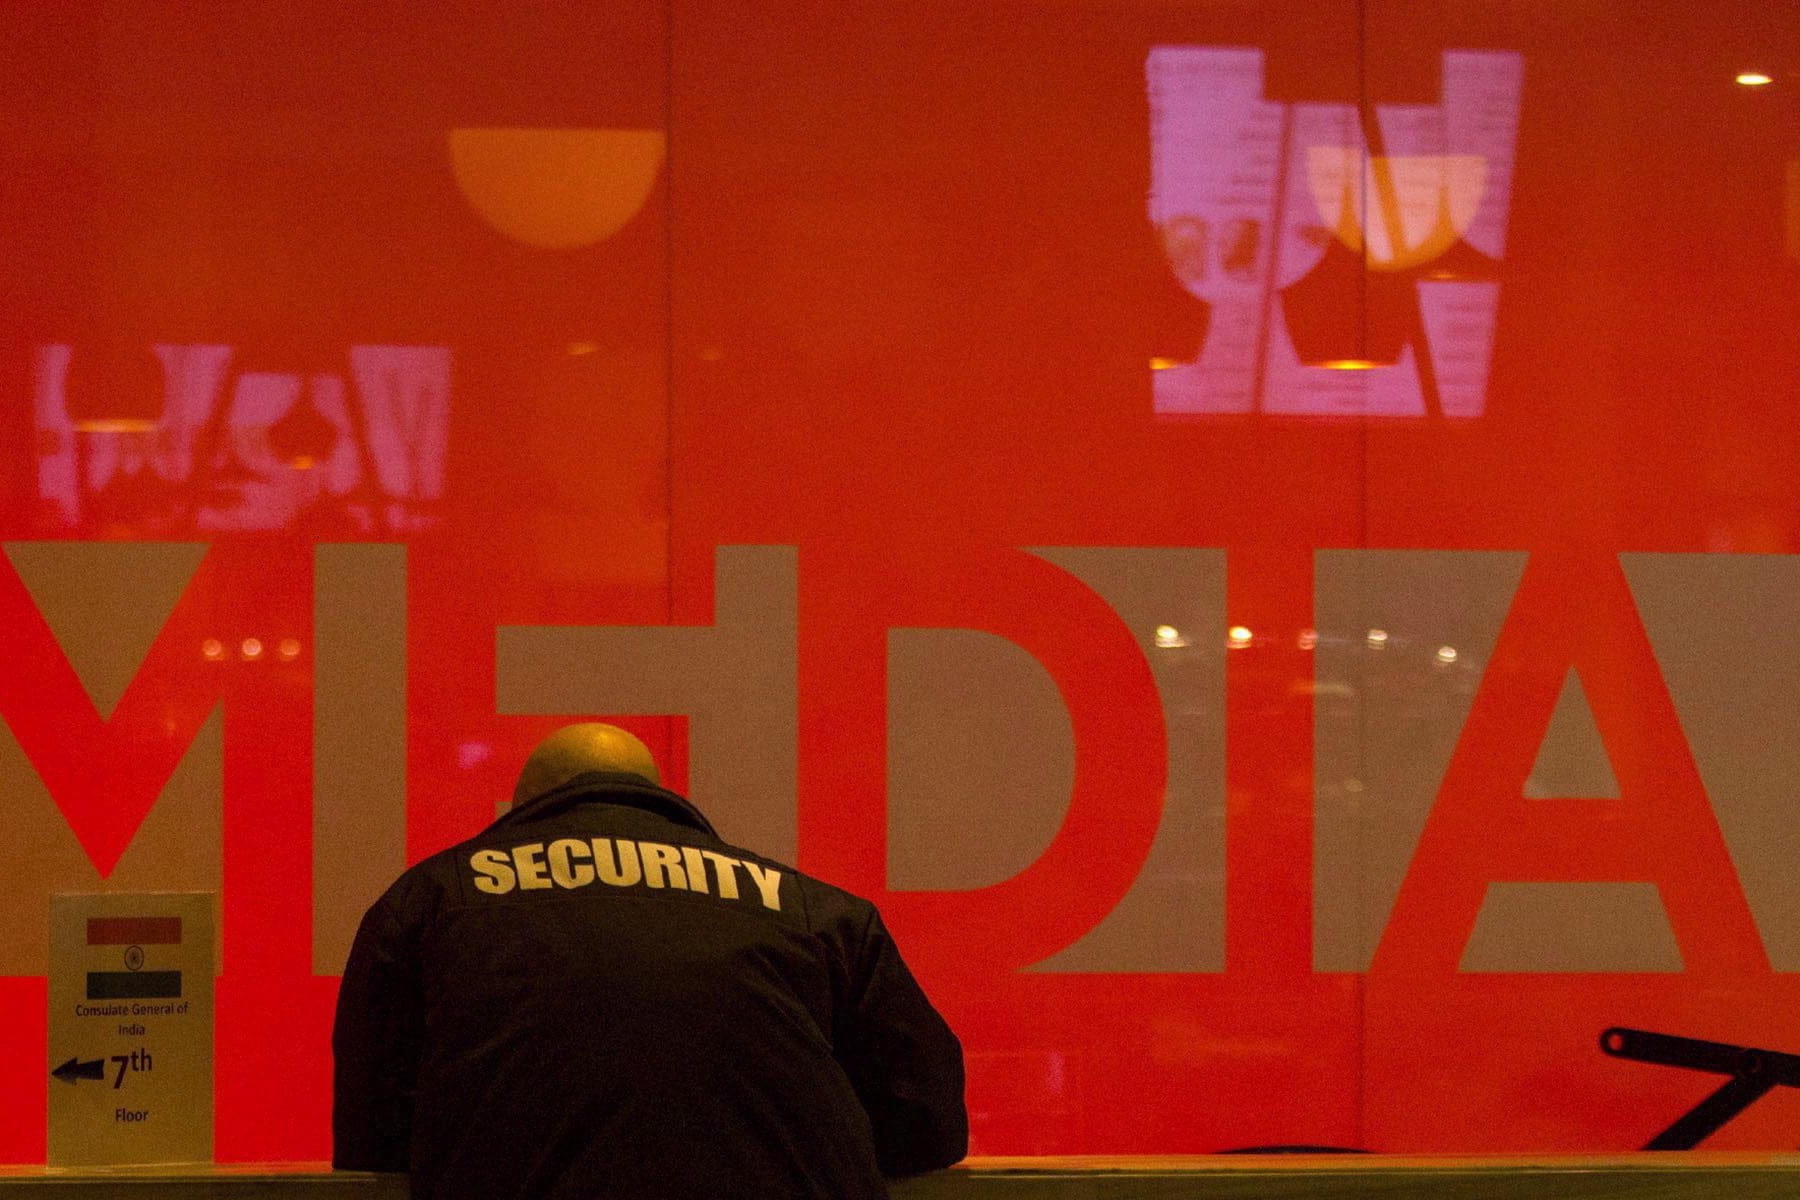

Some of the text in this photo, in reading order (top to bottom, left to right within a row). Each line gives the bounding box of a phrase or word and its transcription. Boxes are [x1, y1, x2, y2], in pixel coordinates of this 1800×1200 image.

[469, 837, 782, 912] SECURITY
[75, 1001, 189, 1017] Consulate General of
[118, 1023, 146, 1037] India
[111, 1048, 153, 1090] 7th
[115, 1108, 149, 1122] Floor
